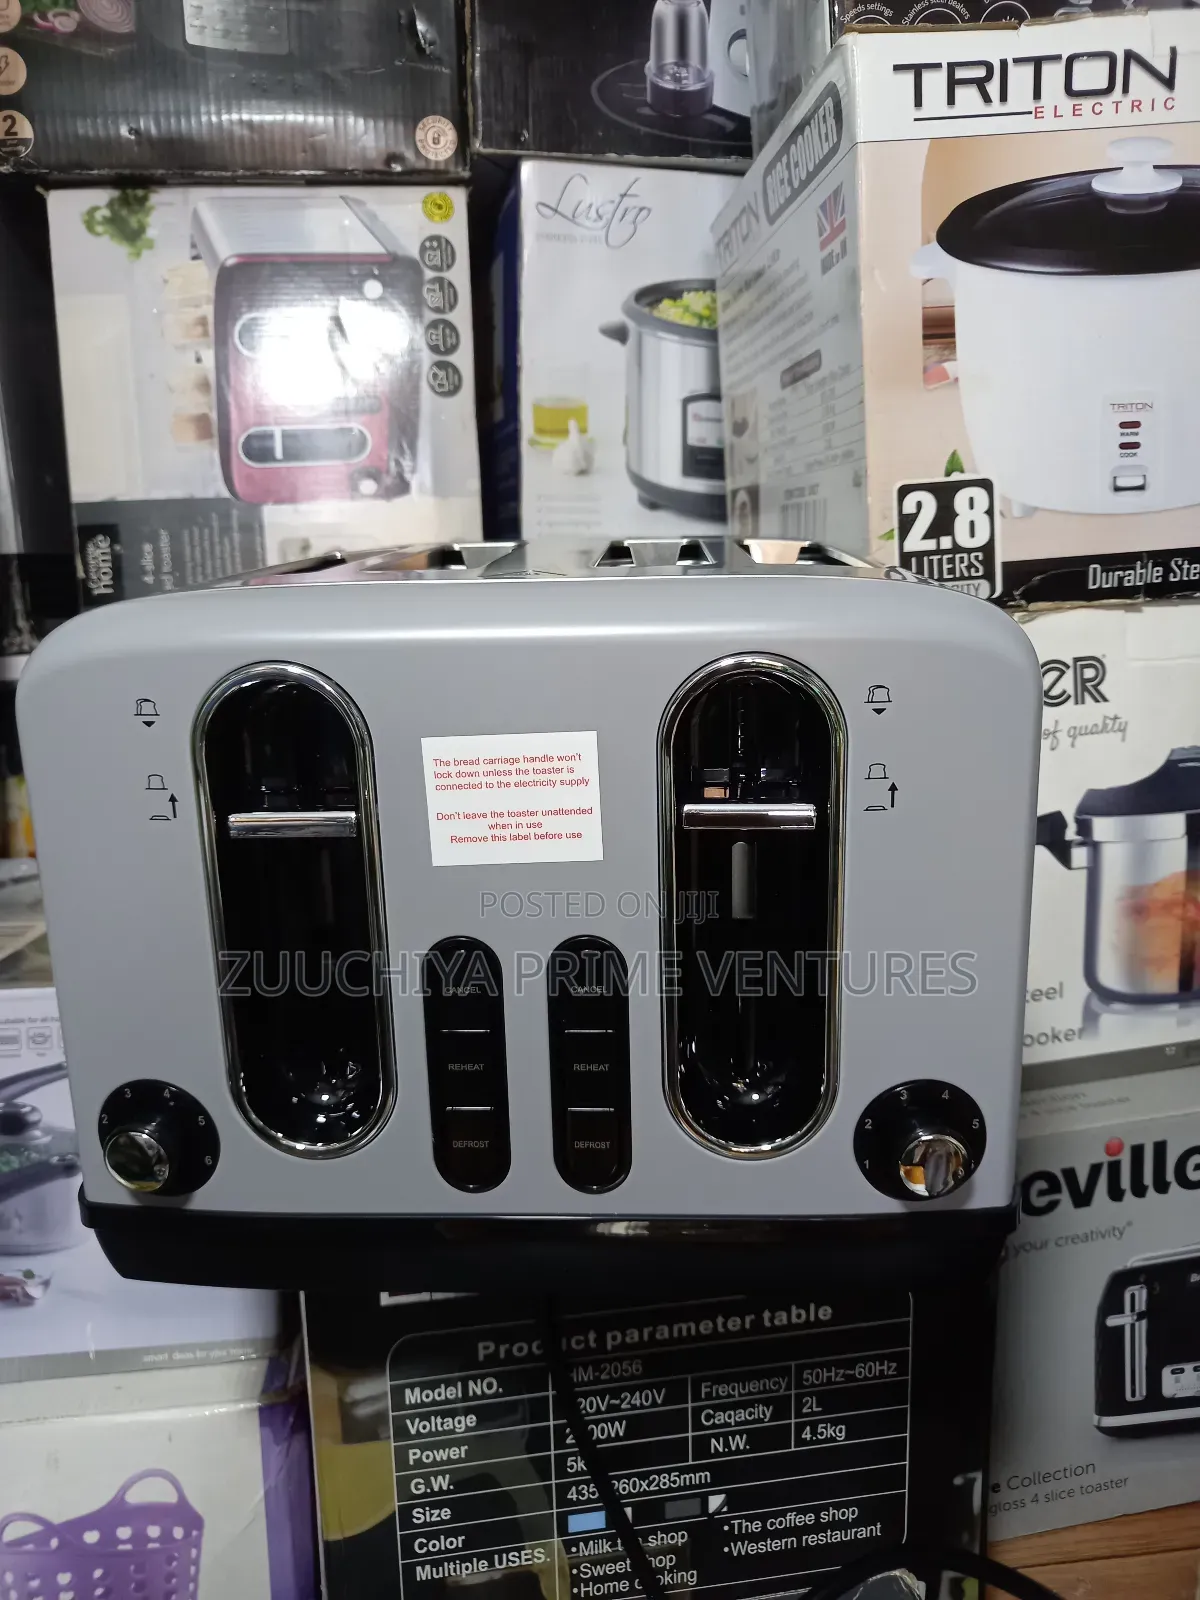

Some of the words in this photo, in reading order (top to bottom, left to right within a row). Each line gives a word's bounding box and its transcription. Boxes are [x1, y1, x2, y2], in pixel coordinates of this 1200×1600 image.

[840, 4, 866, 24] Speeds
[866, 3, 894, 17] settings
[893, 45, 1178, 108] TRITON
[1033, 97, 1177, 120] ELECTRIC
[2, 114, 18, 137] 2
[766, 154, 792, 217] RICE
[789, 96, 838, 189] COOKER
[1109, 402, 1154, 411] TRITON
[902, 485, 992, 552] 2.8
[159, 528, 174, 573] toaster
[93, 533, 114, 595] home
[911, 551, 985, 580] LITERS
[1088, 559, 1164, 590] Durable
[1168, 557, 1200, 582] Ste
[1042, 719, 1063, 751] of
[1067, 714, 1129, 748] quality
[433, 758, 451, 767] The
[453, 757, 480, 767] bread
[482, 755, 521, 766] carriage
[523, 753, 555, 764] handle
[556, 752, 582, 762] won't
[433, 770, 453, 779] lock
[455, 769, 480, 778] down
[482, 768, 513, 777] unless
[515, 767, 530, 776] the
[532, 766, 565, 775] toaster
[567, 765, 575, 774] is
[435, 781, 483, 791] connected
[485, 780, 494, 789] to
[497, 779, 511, 789] the
[513, 778, 557, 789] electricity
[559, 777, 590, 788] supply
[436, 811, 460, 821] Don't
[462, 811, 488, 820] leave
[490, 810, 505, 819] the
[507, 809, 539, 818] toaster
[541, 807, 593, 817] unattended
[488, 822, 513, 830] when
[515, 821, 524, 829] in
[450, 834, 488, 844] Remove
[490, 833, 507, 842] this
[509, 832, 532, 841] label
[533, 831, 563, 841] before
[565, 832, 582, 840] use
[444, 986, 481, 994] CANCEL
[570, 985, 607, 993] CANCEL
[1025, 981, 1064, 1003] eel
[448, 1063, 484, 1071] REHEAT
[573, 1063, 610, 1071] REHEAT
[124, 1088, 132, 1098] 3
[163, 1088, 170, 1099] 4
[900, 1089, 908, 1100] 3
[941, 1089, 950, 1100] 4
[101, 1113, 108, 1124] 2
[198, 1115, 206, 1126] 5
[864, 1118, 872, 1129] 2
[971, 1118, 980, 1129] 5
[452, 1140, 489, 1148] DEFROST
[574, 1141, 611, 1149] DEFROST
[205, 1155, 213, 1165] 6
[863, 1159, 869, 1170] 1
[606, 1312, 756, 1350] parameter
[762, 1302, 833, 1328] table
[802, 1360, 898, 1385] 50Hz~60Hz
[404, 1382, 462, 1405] Model
[468, 1376, 503, 1398] NO.
[701, 1374, 788, 1399] Frequency
[802, 1396, 823, 1413] 2L
[406, 1412, 477, 1435] Voltage
[701, 1403, 773, 1427] Caqacity
[801, 1423, 847, 1442] 4.5kg
[710, 1433, 750, 1454] N.W.
[408, 1444, 469, 1466] Power
[410, 1473, 454, 1495] G.W.
[1006, 1462, 1096, 1491] Collection
[988, 1496, 1027, 1517] gloss
[1030, 1493, 1039, 1505] 4
[1044, 1487, 1075, 1504] slice
[1079, 1476, 1129, 1496] toaster
[411, 1506, 452, 1525] Size
[730, 1518, 763, 1535] The
[767, 1511, 816, 1531] coffee
[819, 1505, 859, 1523] shop
[413, 1533, 466, 1554] Color
[579, 1538, 613, 1557] Milk
[648, 1530, 688, 1547] shop
[730, 1537, 797, 1557] Western
[802, 1522, 882, 1547] restaurant
[416, 1560, 495, 1582] Multiple
[494, 1547, 551, 1569] USES.
[579, 1559, 632, 1579] Sweet
[580, 1578, 625, 1598] Home
